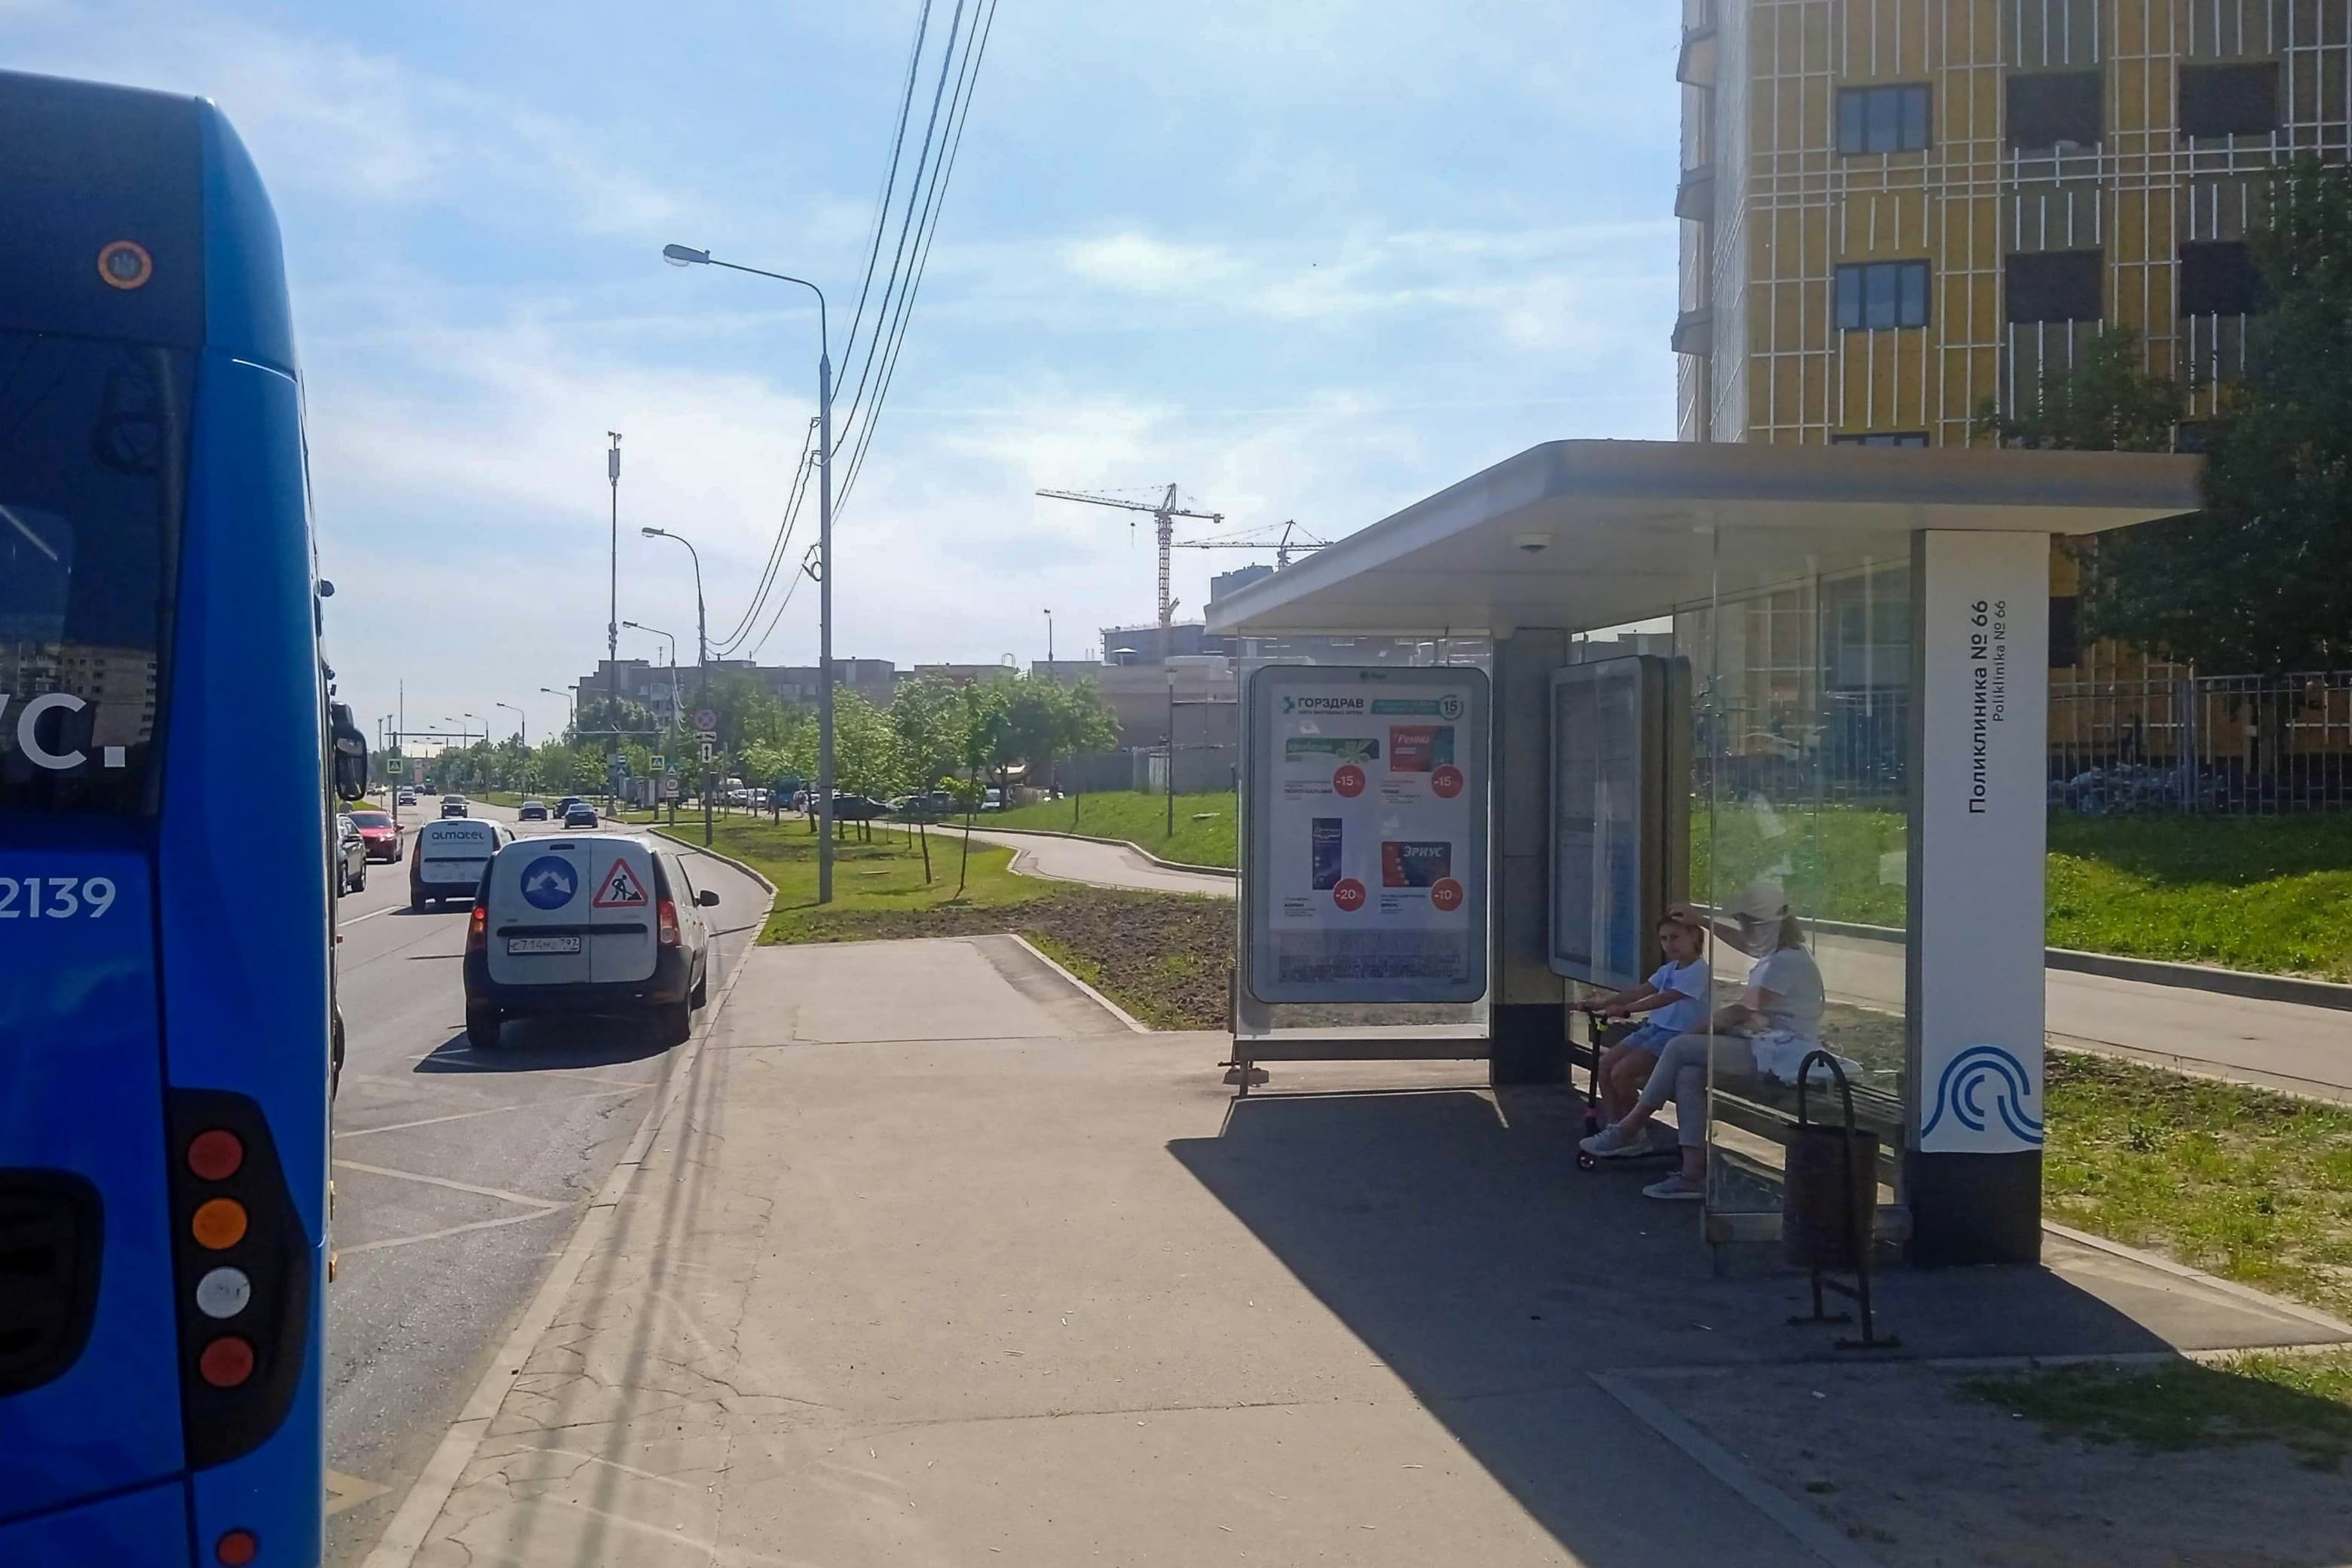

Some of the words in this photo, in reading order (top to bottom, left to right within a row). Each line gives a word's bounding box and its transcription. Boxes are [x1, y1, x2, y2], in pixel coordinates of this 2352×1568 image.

[1971, 600, 1989, 627] 66
[1994, 600, 2006, 618] 66
[1971, 633, 1988, 660] №
[1992, 645, 2005, 721] Poliklinika
[1297, 697, 1364, 709] ГОРЗДРАВ
[1443, 700, 1459, 712] 15
[1969, 667, 1987, 813] Поликлиника
[431, 831, 485, 840] almatel
[1403, 845, 1444, 857] ЭРИУС
[0, 877, 117, 918] 2139
